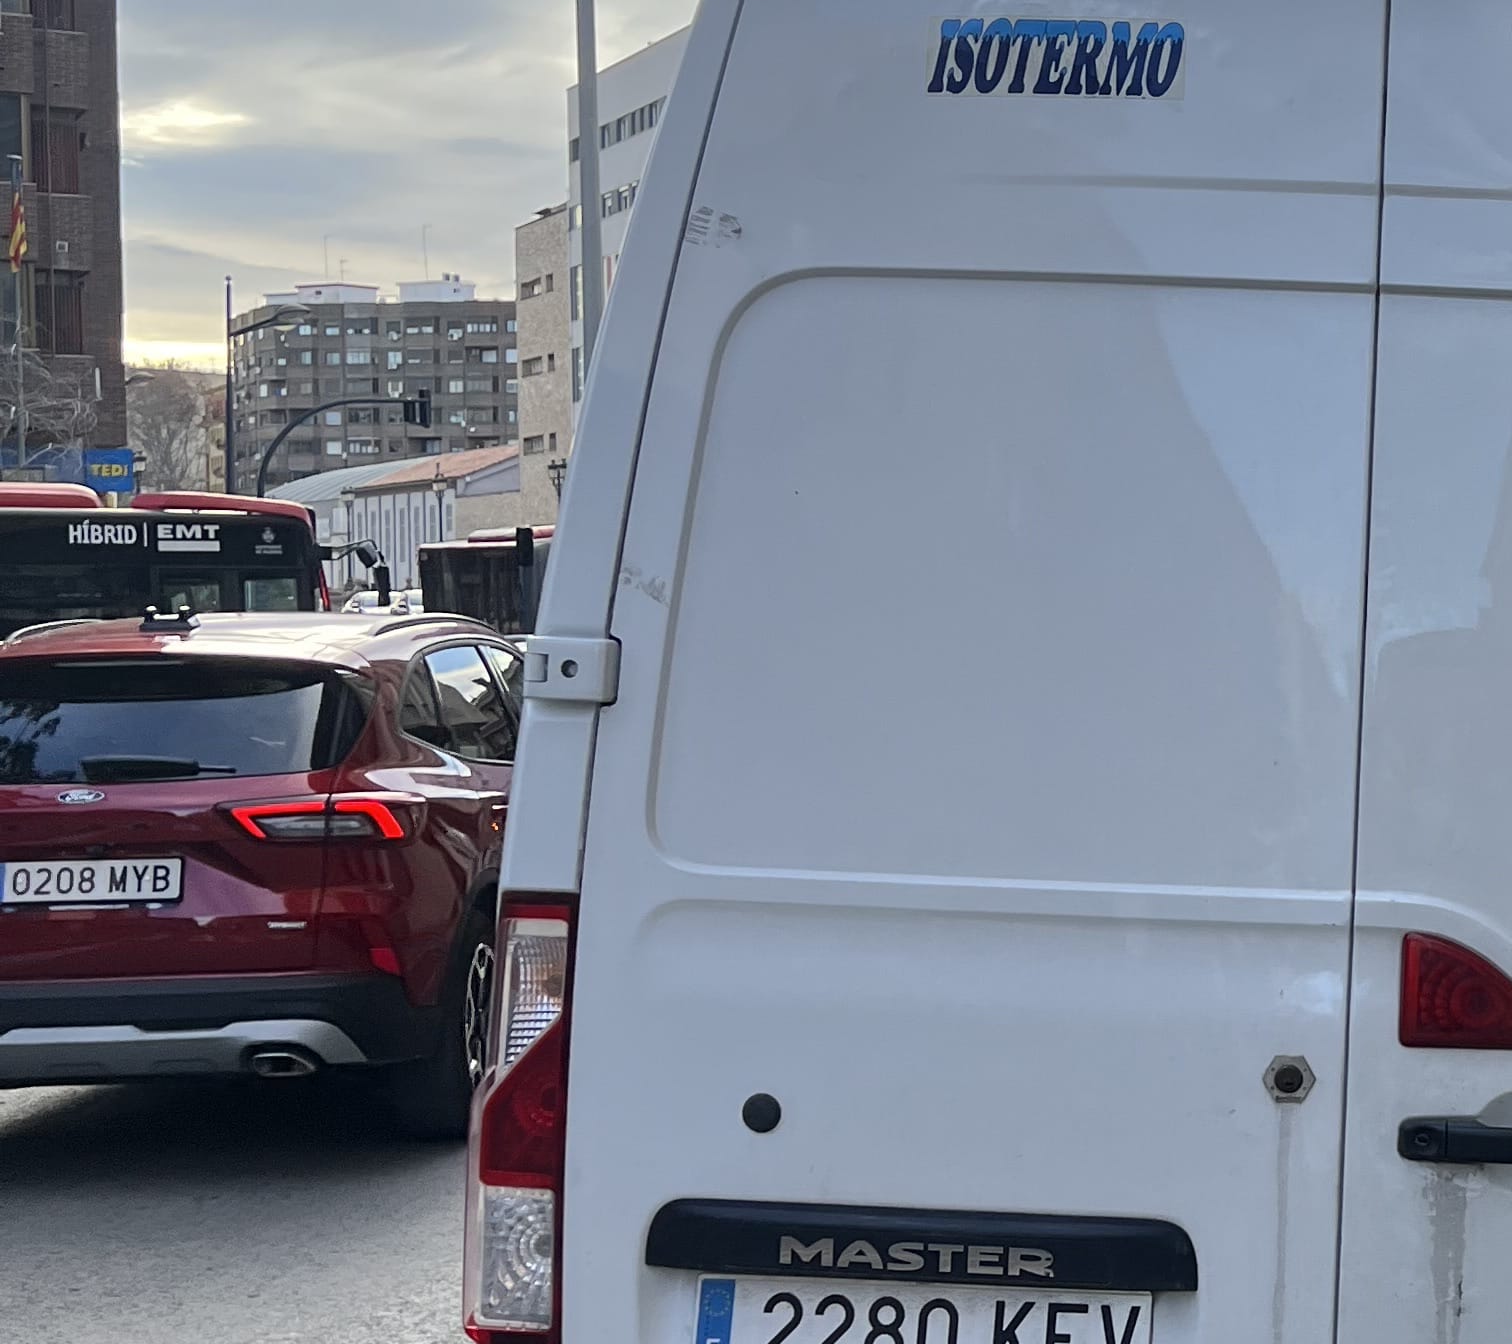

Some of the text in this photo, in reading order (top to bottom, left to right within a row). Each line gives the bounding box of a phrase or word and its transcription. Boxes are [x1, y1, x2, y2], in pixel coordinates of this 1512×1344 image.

[927, 18, 1185, 97] ISOTERMO
[68, 519, 220, 544] HÍBRID EMT
[12, 865, 171, 896] 0208 MYB
[779, 1236, 1054, 1278] MASTER
